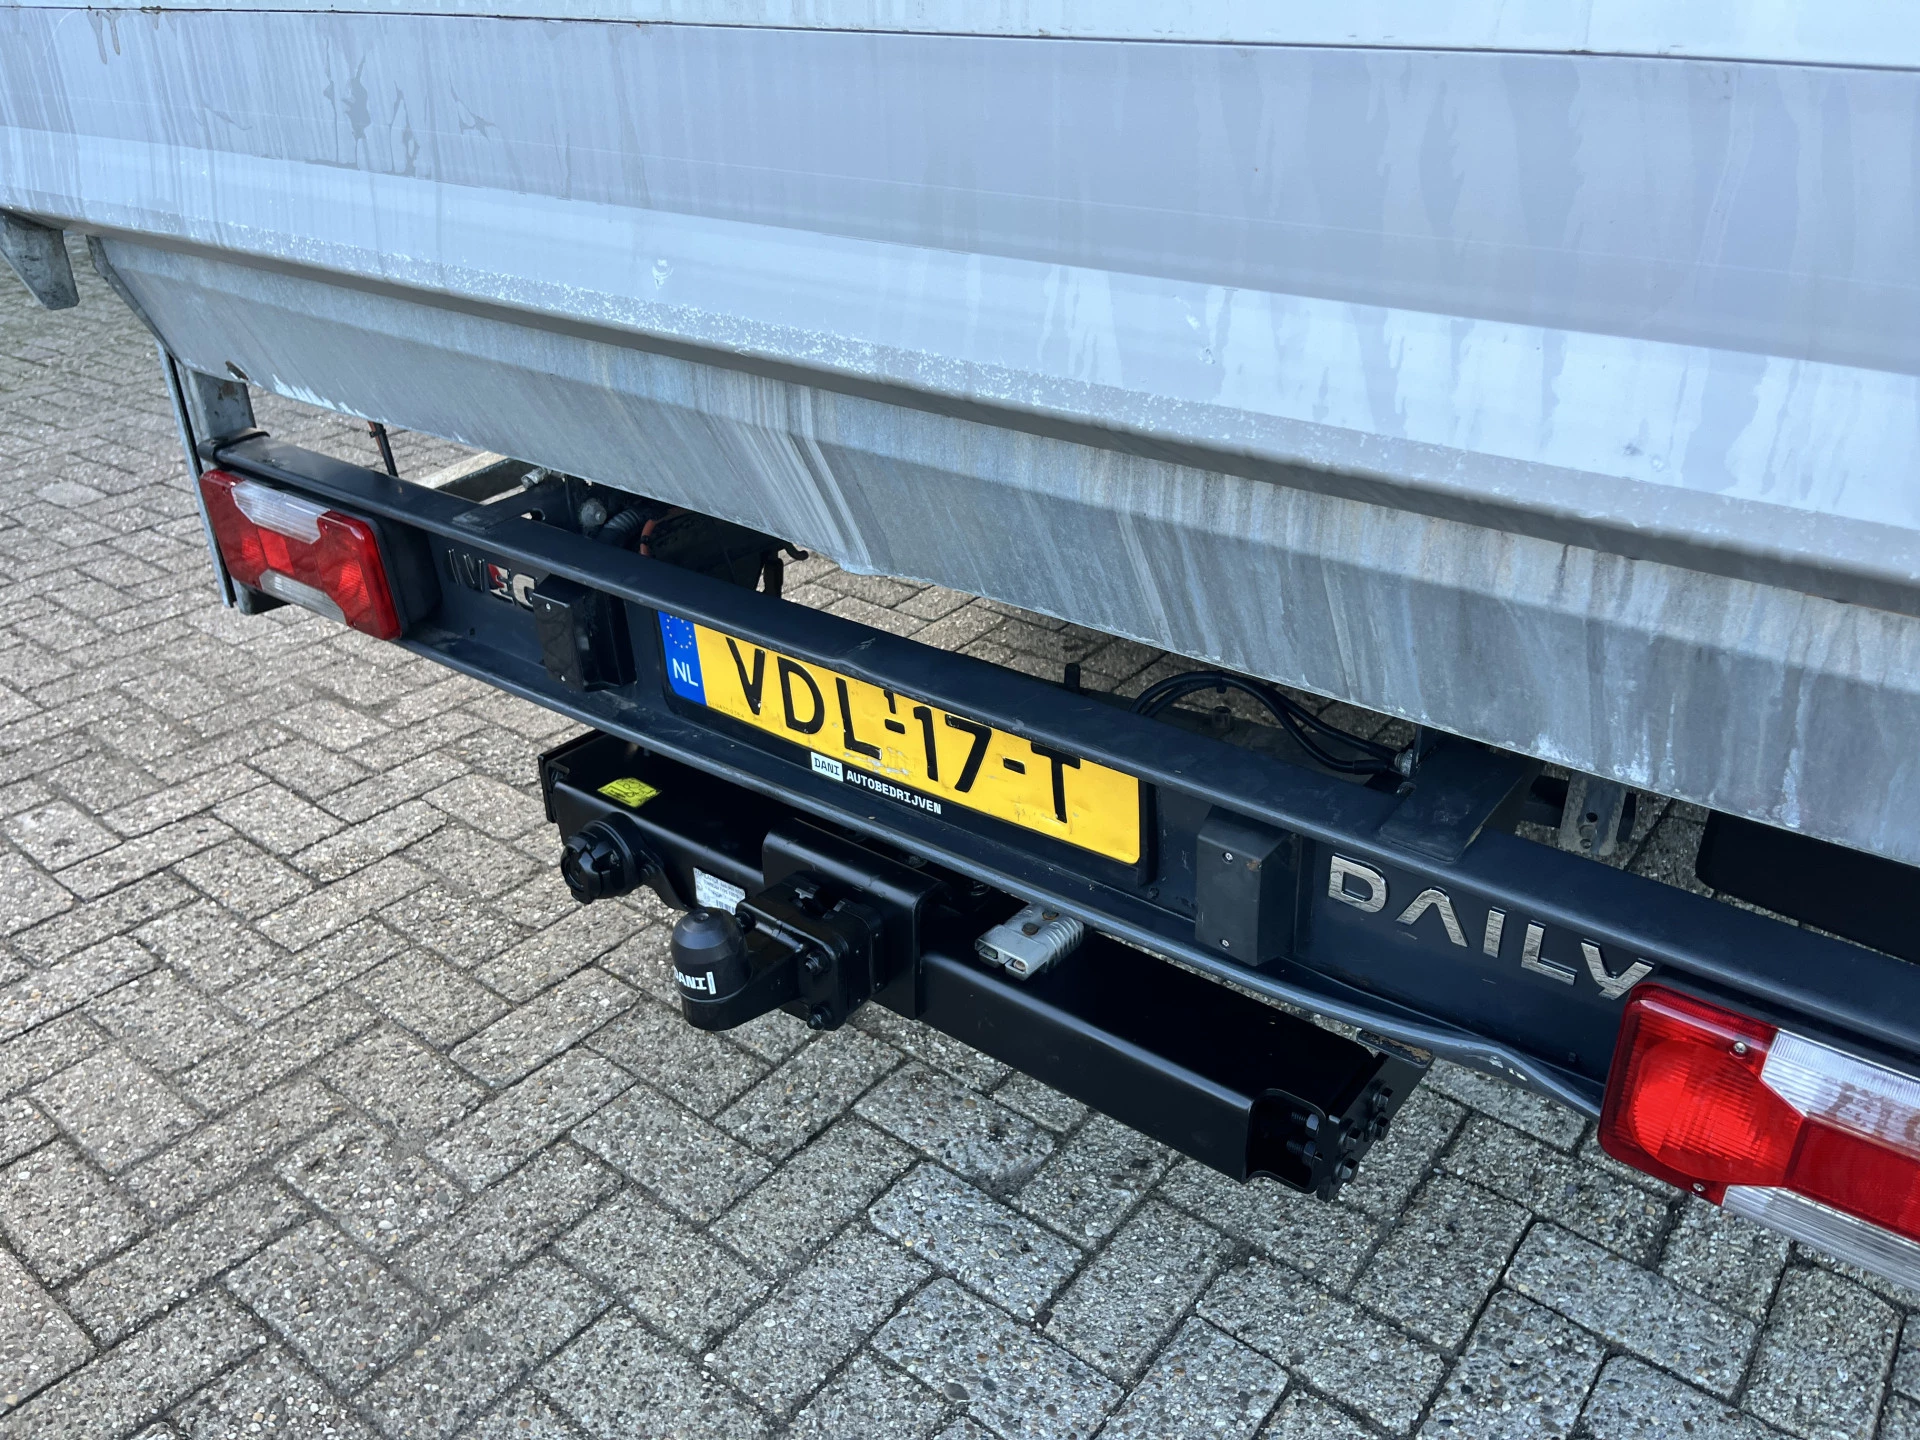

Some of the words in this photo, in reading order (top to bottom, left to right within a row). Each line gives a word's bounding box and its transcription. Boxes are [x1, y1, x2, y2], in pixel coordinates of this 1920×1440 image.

[446, 548, 538, 610] IVEC
[672, 657, 700, 687] NL
[724, 637, 1082, 825] VDL-17-T
[813, 757, 841, 777] DANI
[846, 769, 942, 815] AUTOBEDRIJVEN
[1327, 852, 1655, 1001] DAILY
